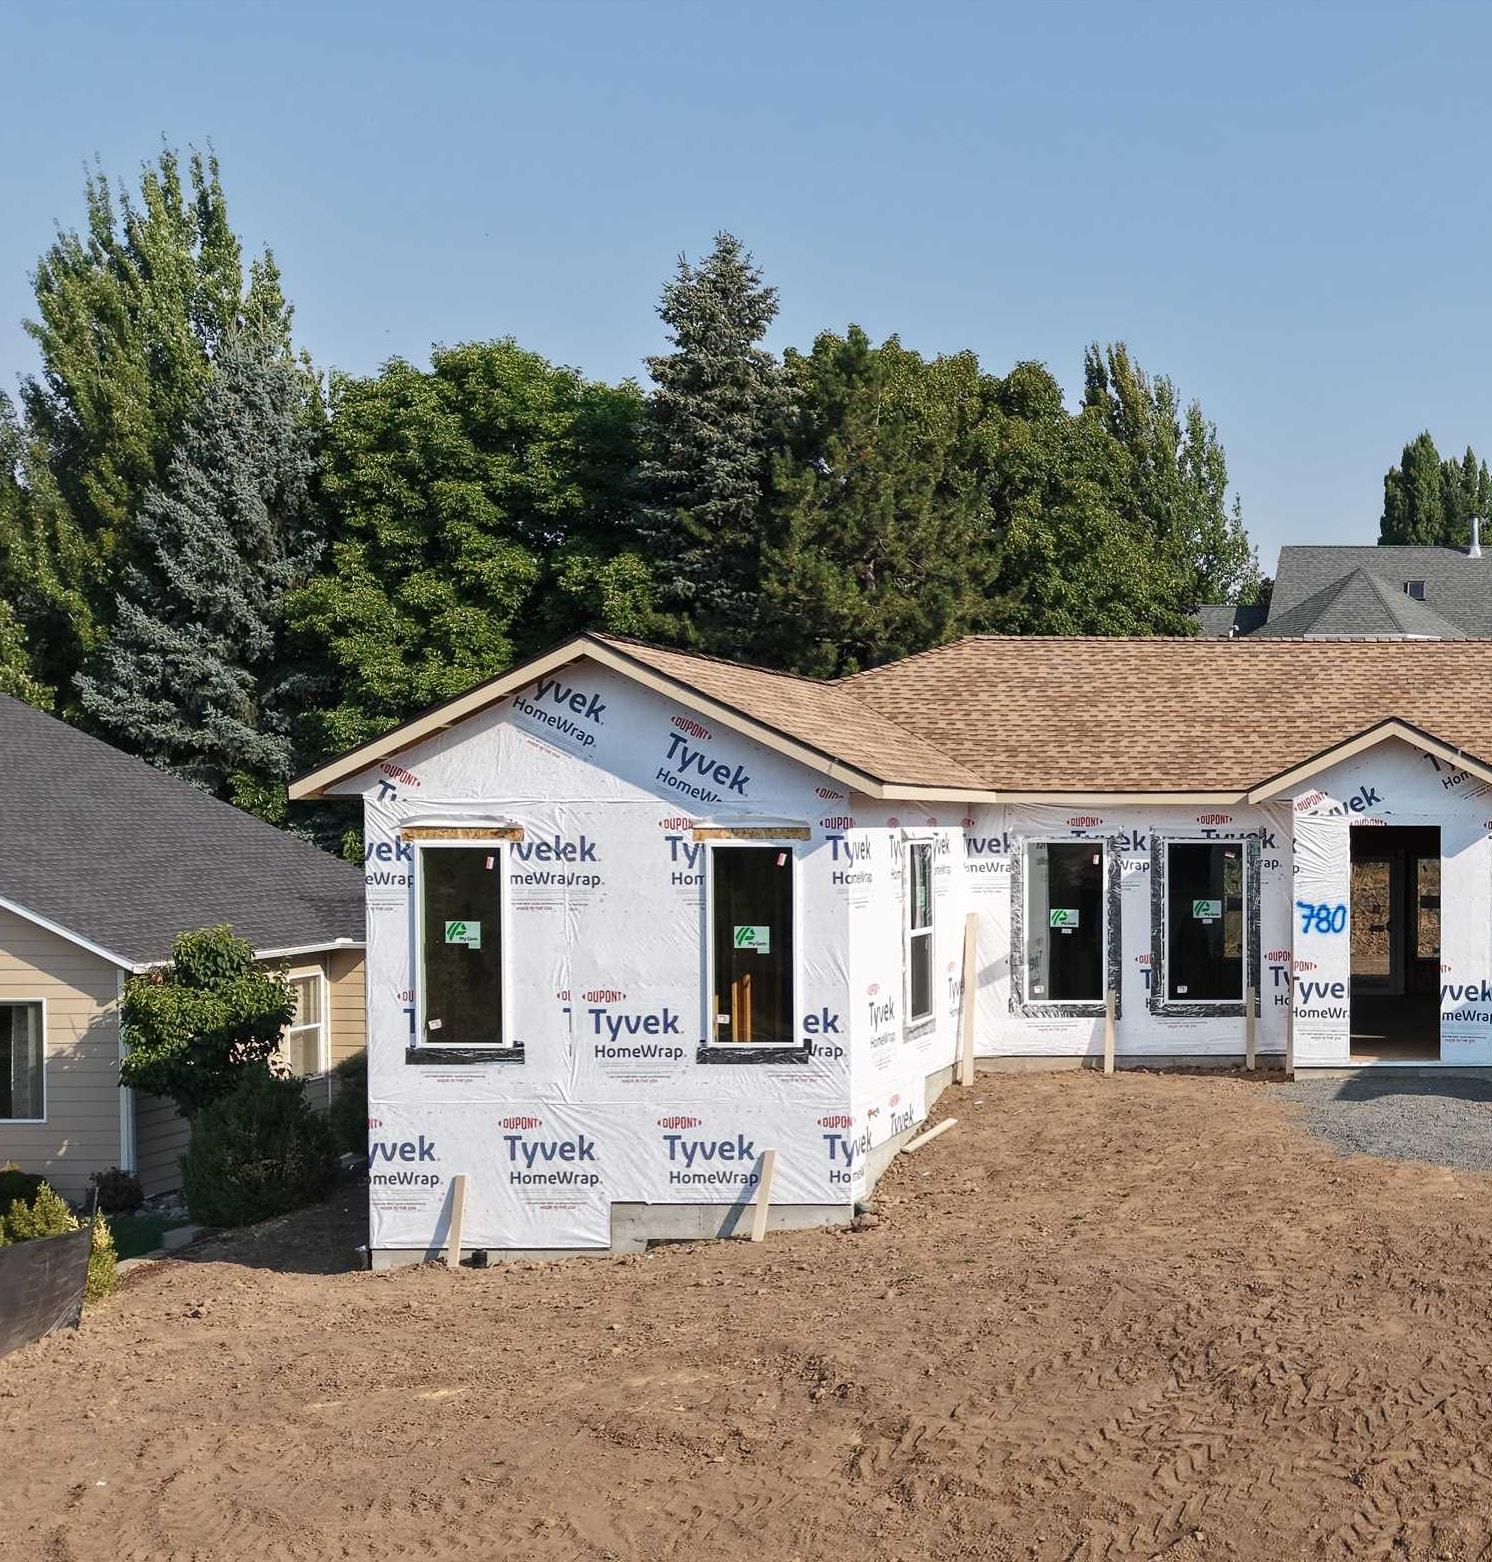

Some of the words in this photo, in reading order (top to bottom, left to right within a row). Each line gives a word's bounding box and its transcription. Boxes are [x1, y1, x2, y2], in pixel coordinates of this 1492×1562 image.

[512, 696, 595, 747] HomeWrap
[675, 716, 708, 739] DUPONT
[666, 733, 750, 796] Tyvek
[1298, 792, 1326, 811] DUPONT
[1071, 817, 1099, 827] DUPONT
[1201, 814, 1229, 825] DUPONT
[1297, 901, 1347, 934] 780
[588, 990, 622, 1002] DUPONT
[588, 1008, 679, 1042] Tyvek
[595, 1045, 683, 1060] HomeWrap
[503, 1118, 538, 1130] DUPONT
[662, 1117, 698, 1129] DUPONT
[504, 1135, 595, 1168] Tyvek
[663, 1134, 754, 1168] Tyvek
[510, 1171, 599, 1187] HomeWrap
[670, 1171, 758, 1186] HomeWrap
